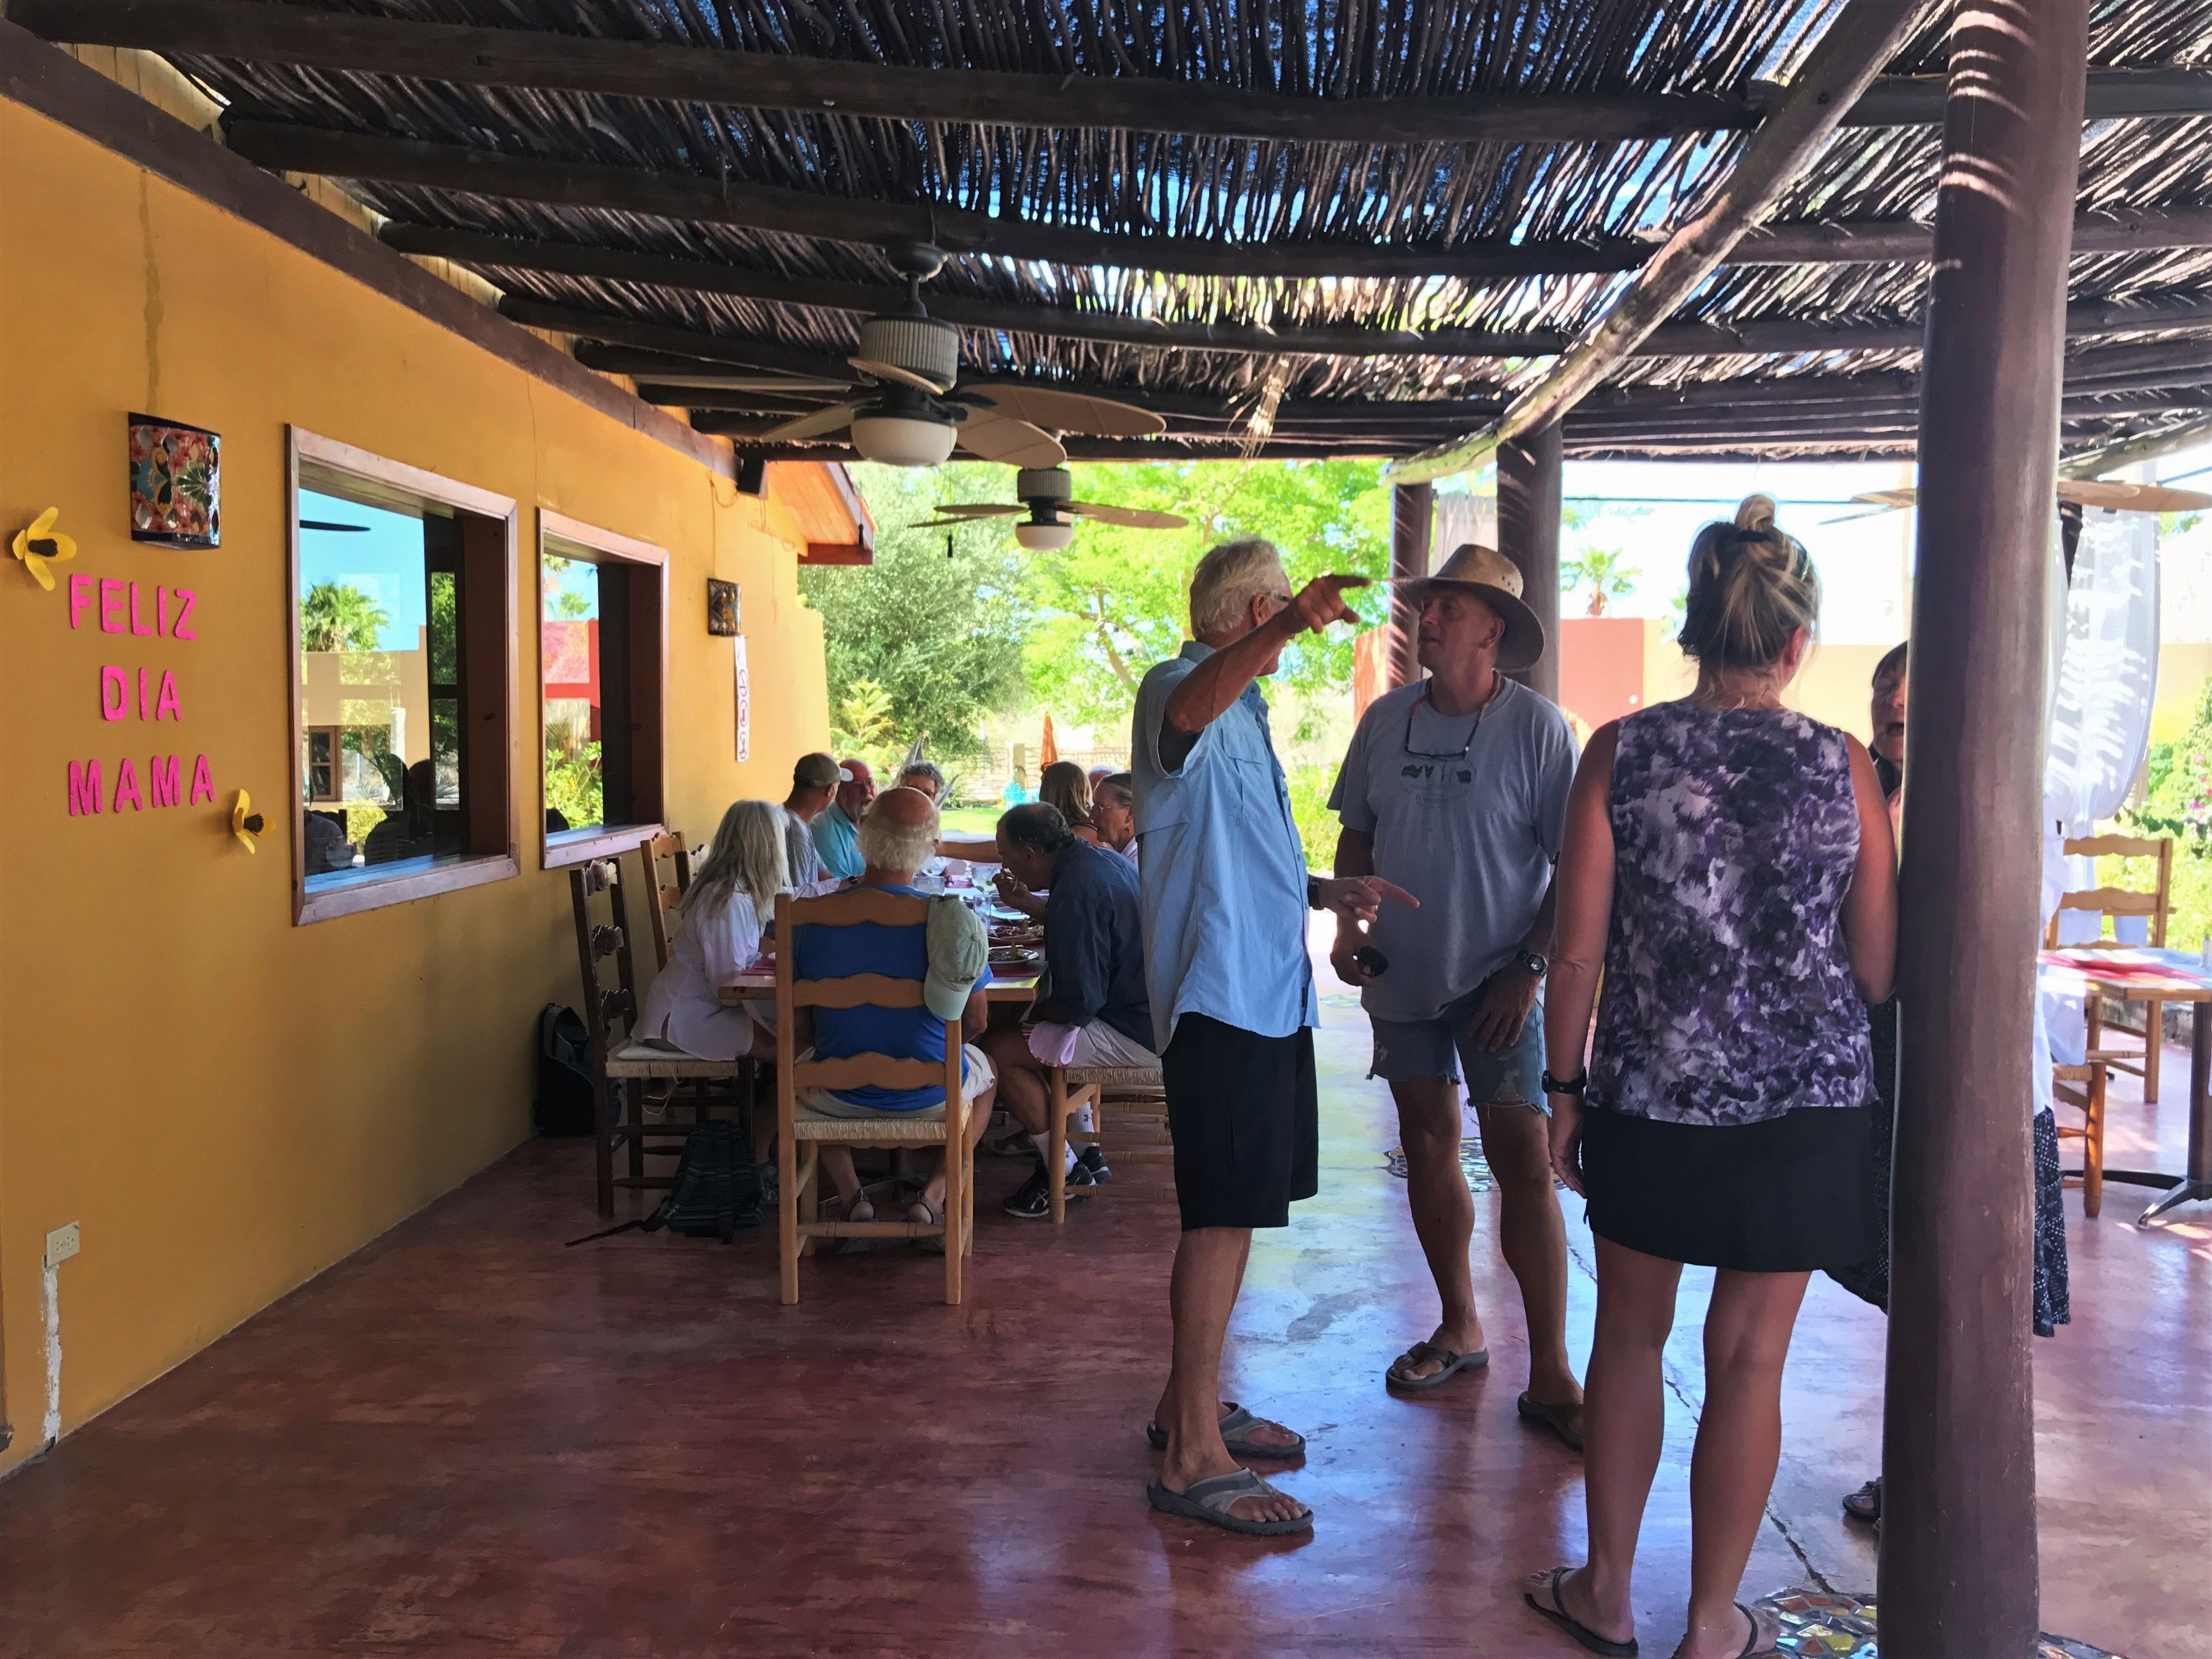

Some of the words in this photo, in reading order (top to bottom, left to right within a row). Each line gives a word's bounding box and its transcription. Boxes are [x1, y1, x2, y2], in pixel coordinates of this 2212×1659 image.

[69, 574, 198, 641] FELIZ
[101, 665, 181, 721] DIA
[69, 755, 215, 816] MAMA
